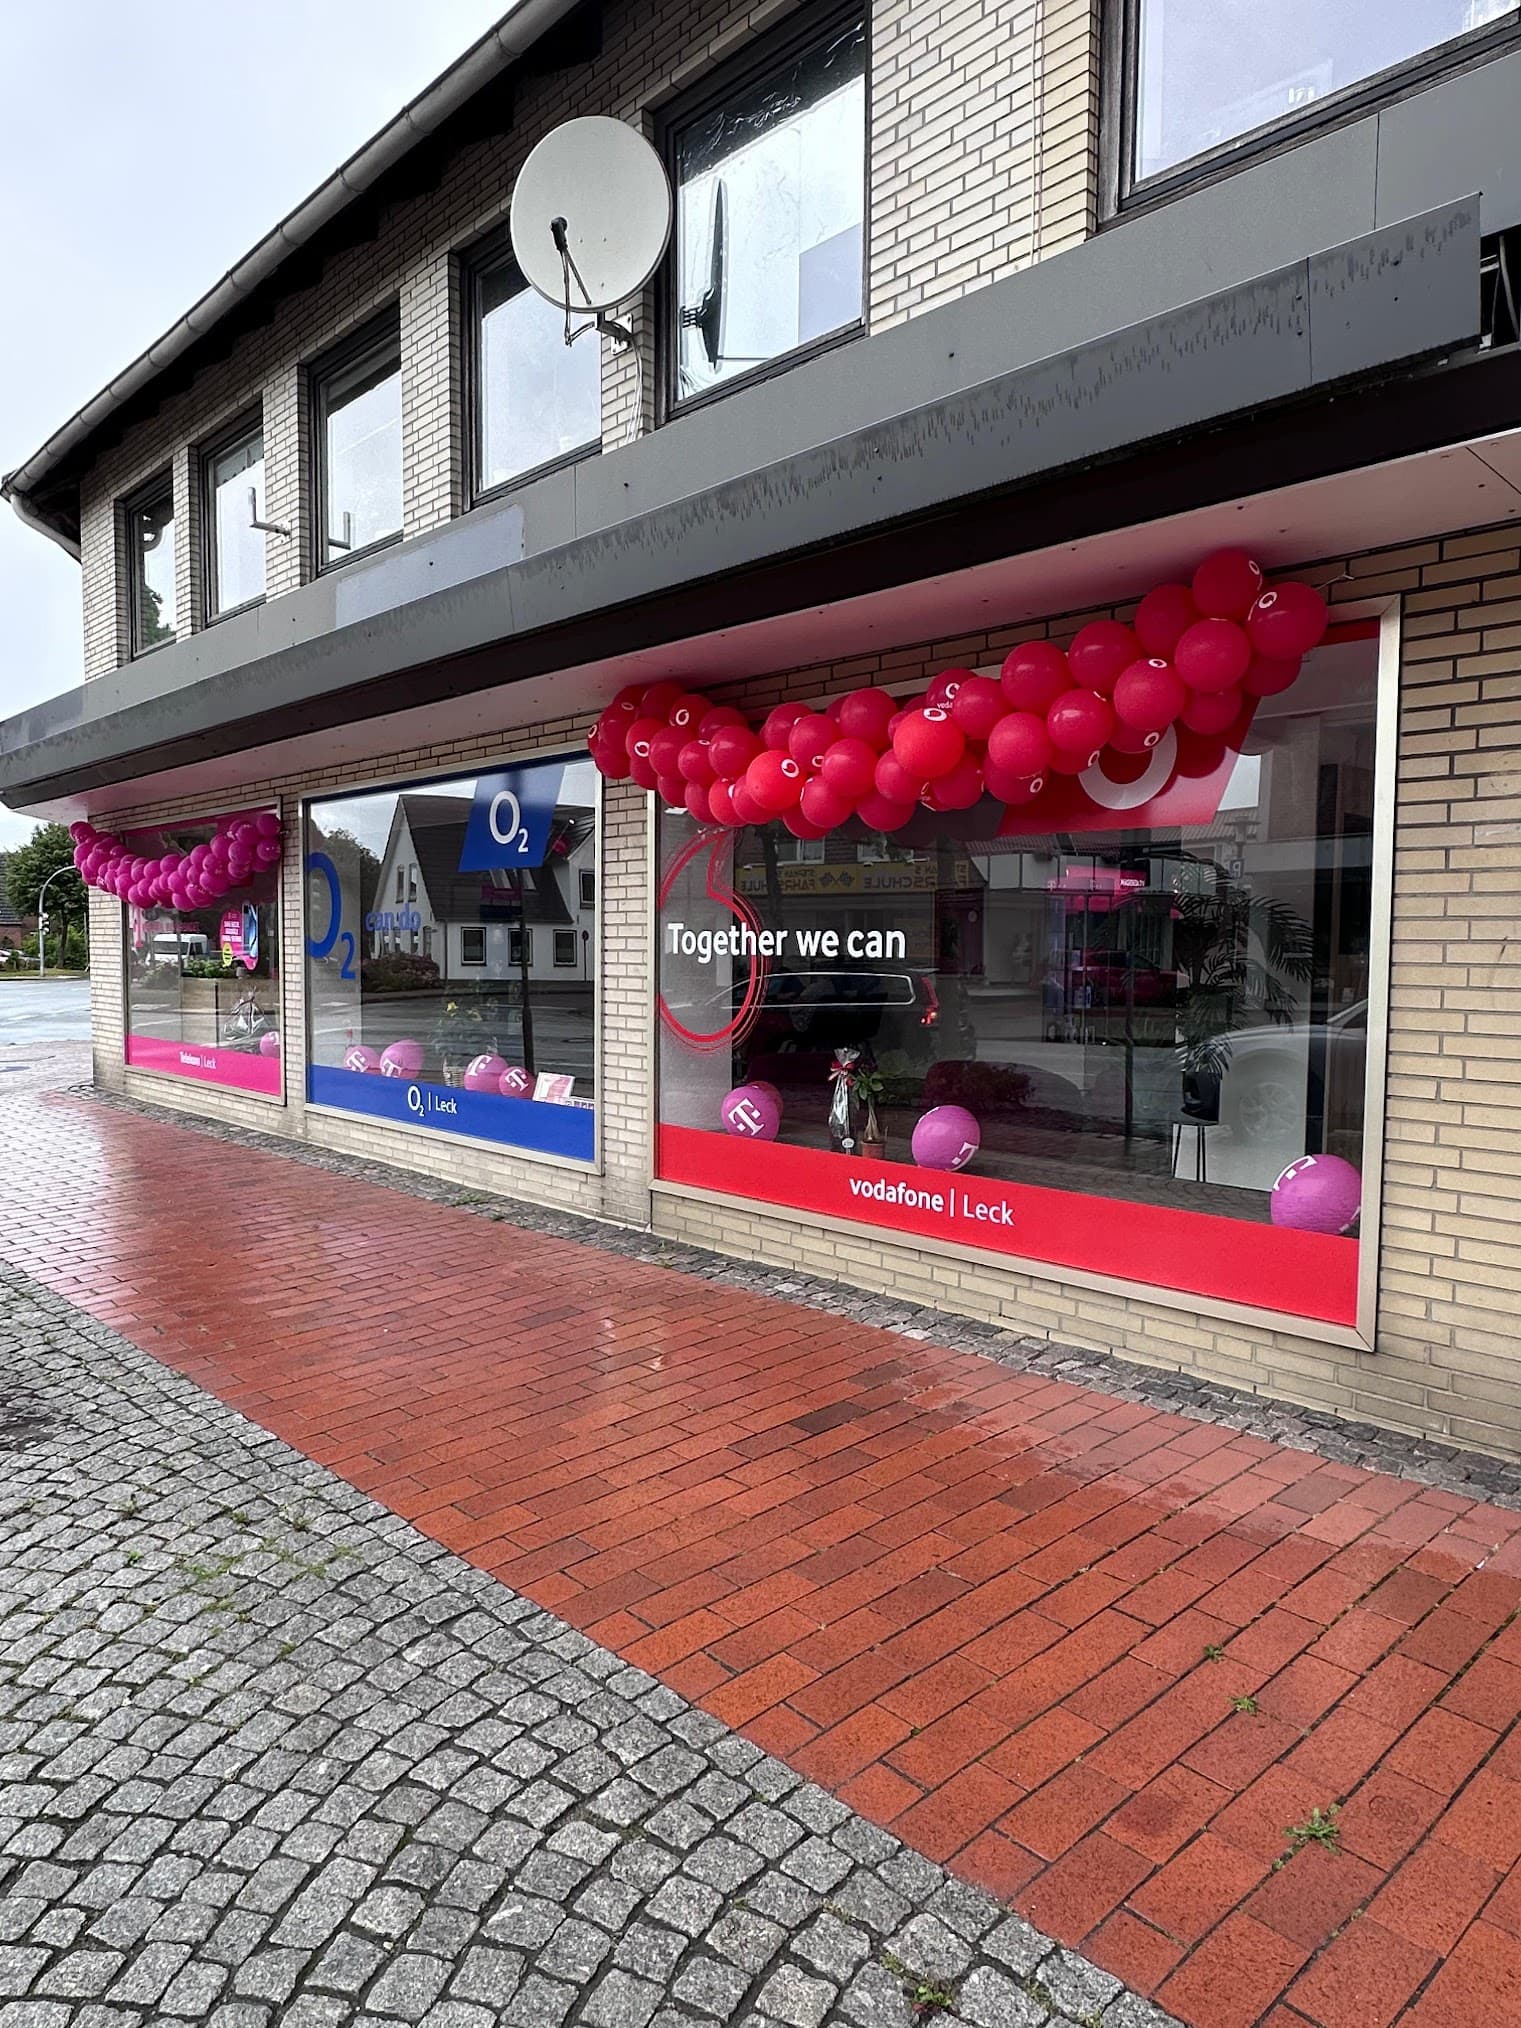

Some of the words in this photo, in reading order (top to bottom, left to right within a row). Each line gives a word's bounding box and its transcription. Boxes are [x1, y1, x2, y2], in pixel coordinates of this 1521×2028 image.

[490, 790, 529, 853] O2
[303, 851, 356, 980] O2
[364, 911, 395, 932] can
[399, 902, 421, 931] do
[667, 922, 789, 964] Together
[796, 929, 840, 958] we
[847, 929, 906, 959] can
[203, 1055, 217, 1070] Leck
[407, 1085, 425, 1117] O2
[435, 1095, 458, 1115] Leck
[728, 1097, 765, 1137] T
[849, 1177, 945, 1213] vodafone
[963, 1194, 1015, 1226] Leck
